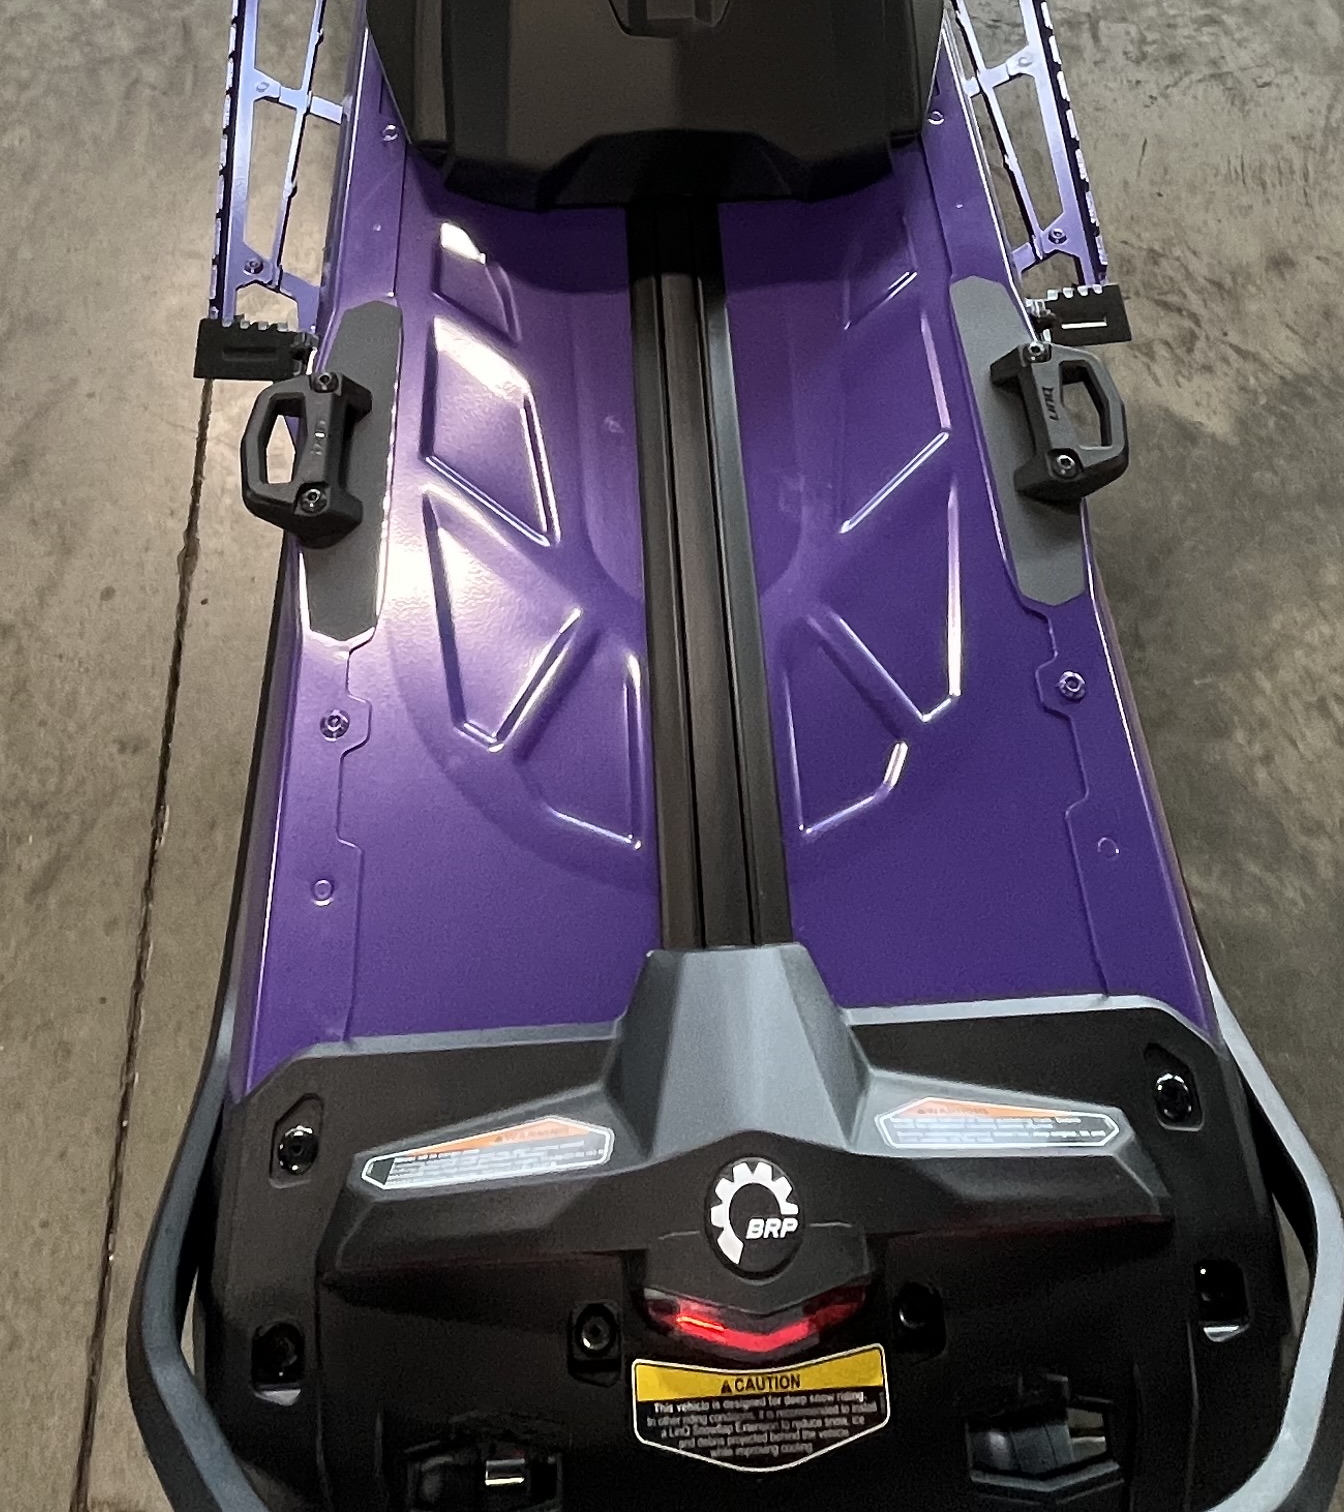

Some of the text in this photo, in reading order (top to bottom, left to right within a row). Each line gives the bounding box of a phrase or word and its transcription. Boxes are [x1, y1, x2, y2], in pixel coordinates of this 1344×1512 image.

[745, 1217, 799, 1240] BRP
[734, 1374, 801, 1393] CAUTION
[654, 1402, 674, 1414] This
[676, 1400, 710, 1412] vehicle
[722, 1397, 766, 1410] designed
[768, 1395, 782, 1407] for
[783, 1394, 808, 1407] deep
[809, 1393, 835, 1404] snow
[657, 1415, 681, 1427] other
[682, 1414, 708, 1426] riding
